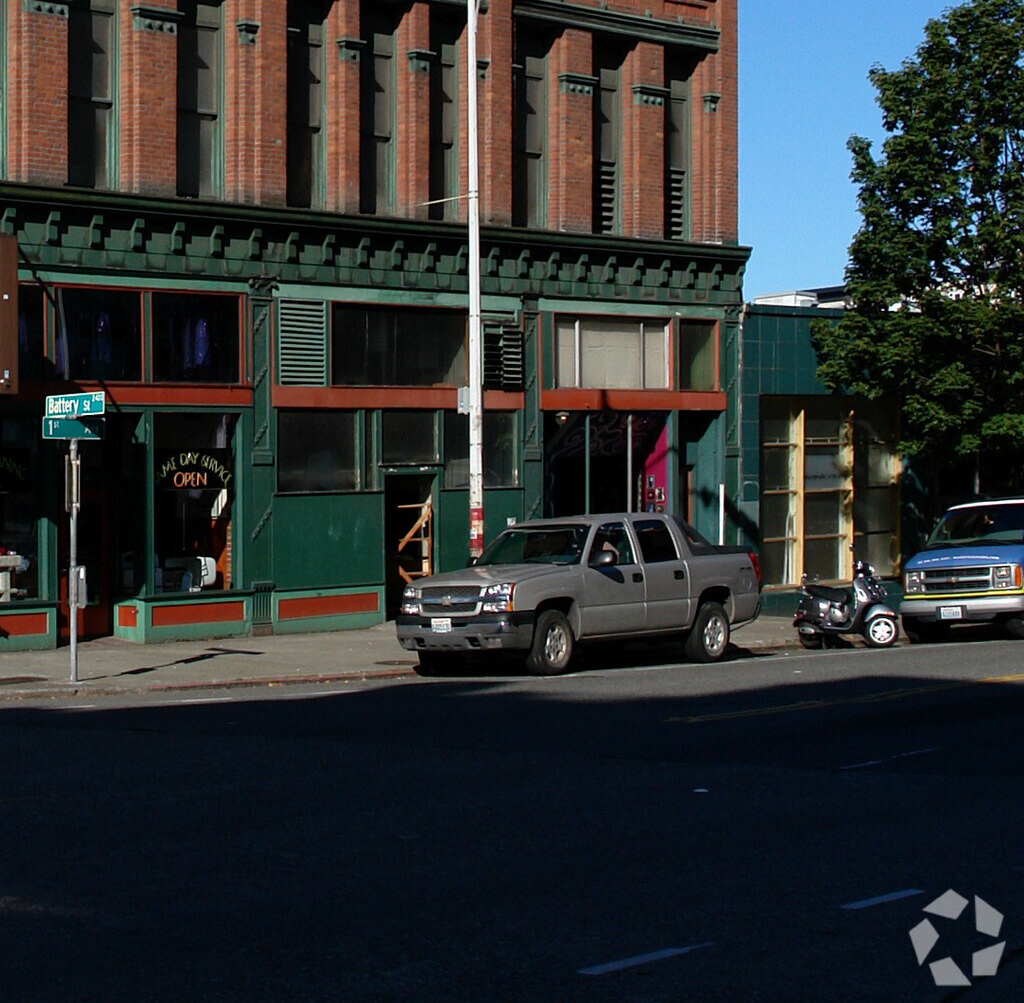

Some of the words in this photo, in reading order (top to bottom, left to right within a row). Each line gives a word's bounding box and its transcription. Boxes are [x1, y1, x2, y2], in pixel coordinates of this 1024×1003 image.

[48, 397, 79, 415] Battery
[179, 452, 199, 466] DAY
[173, 471, 208, 488] OPEN
